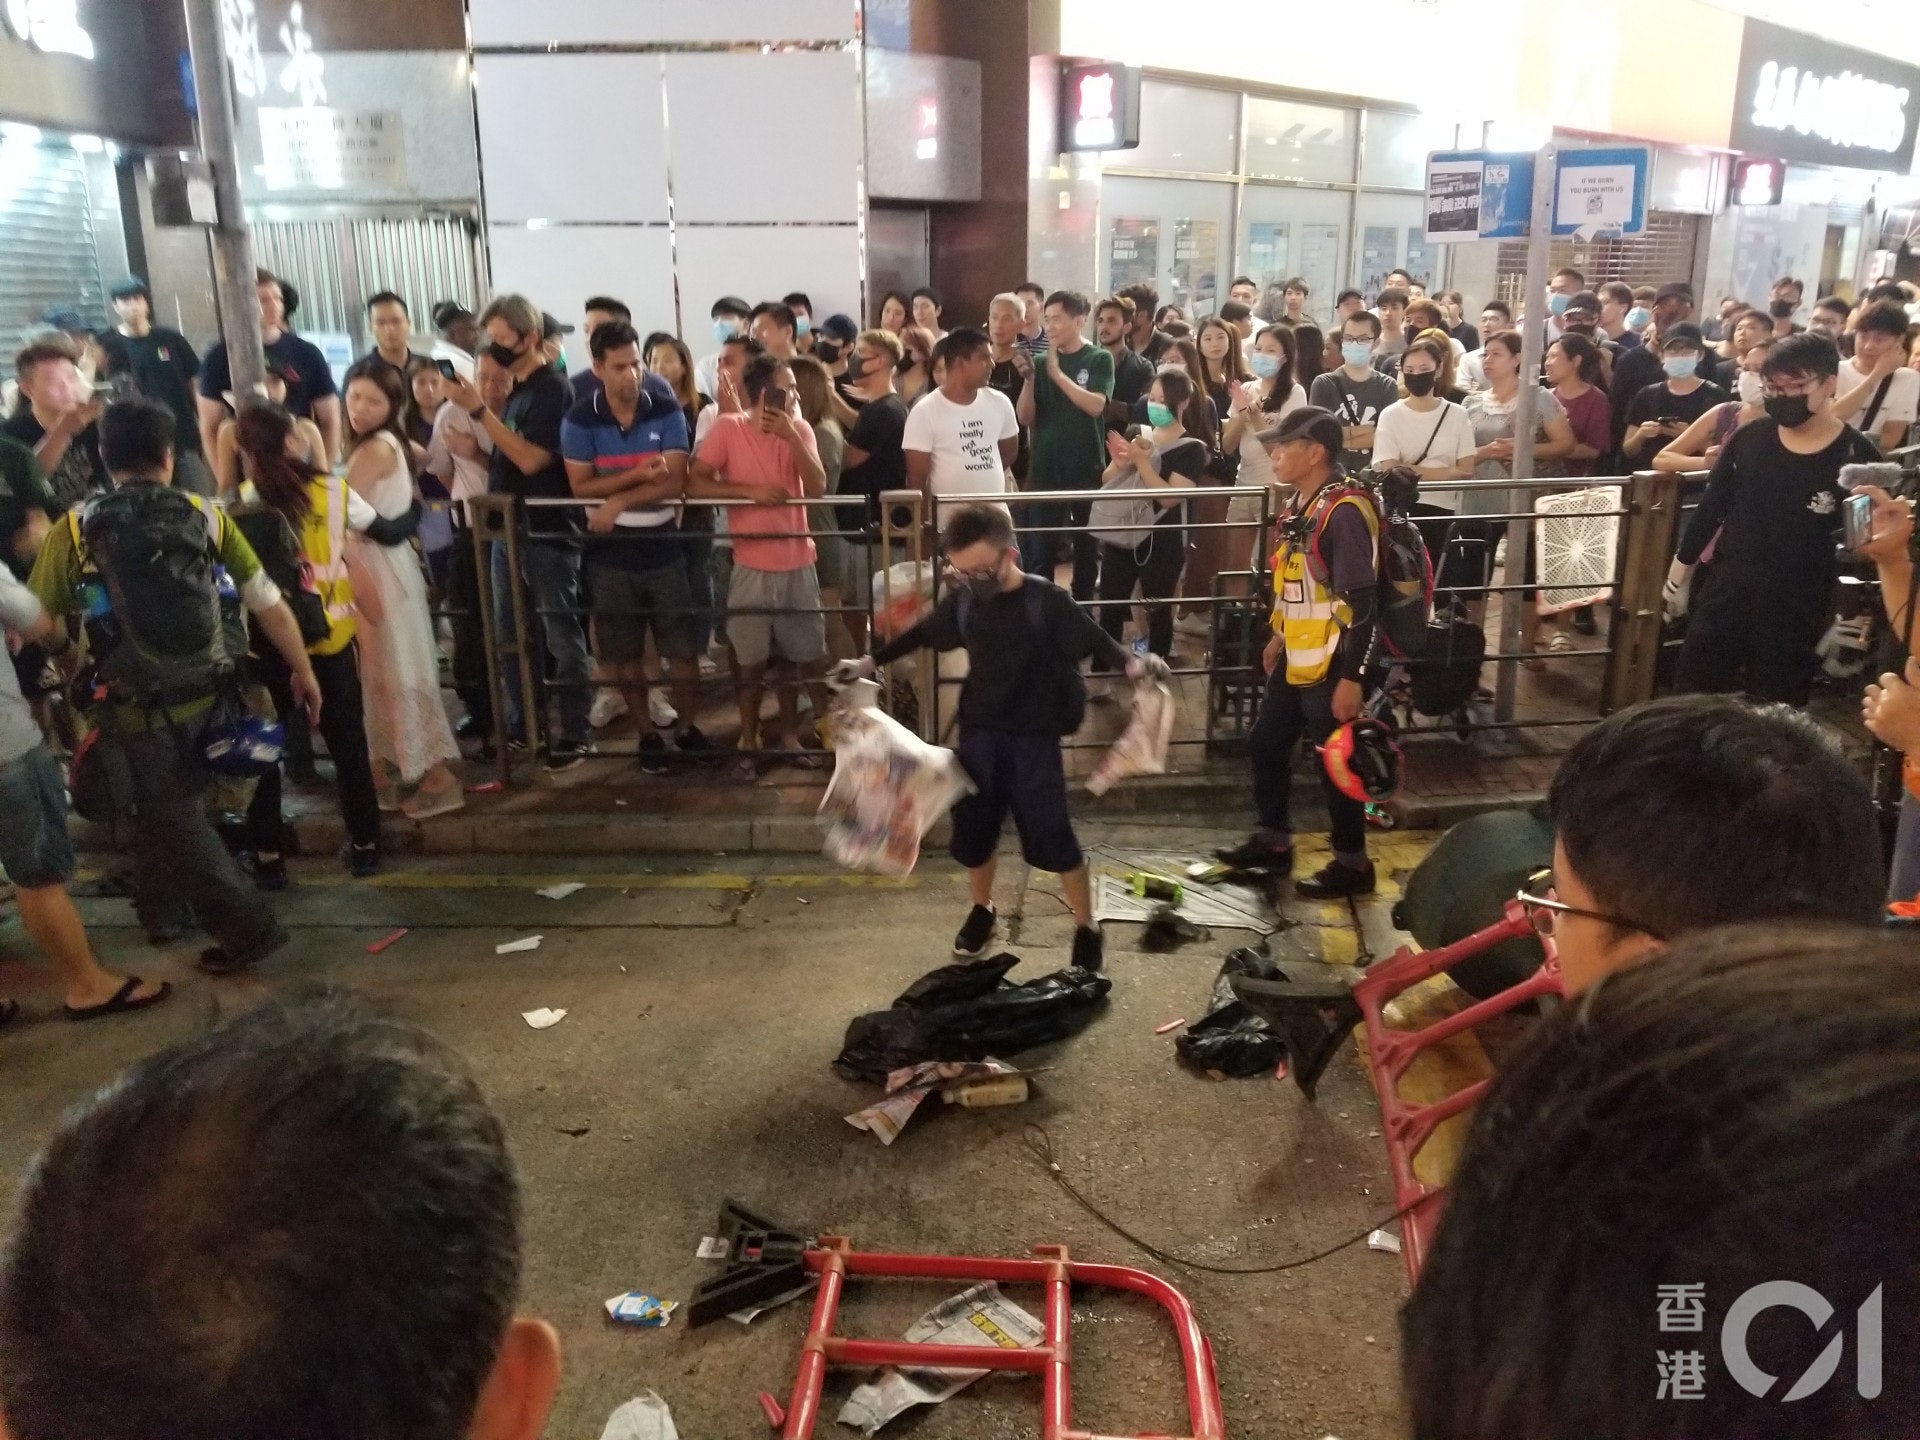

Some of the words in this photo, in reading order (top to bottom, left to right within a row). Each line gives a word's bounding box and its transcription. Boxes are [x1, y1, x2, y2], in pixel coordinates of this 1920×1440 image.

[959, 429, 984, 439] really
[962, 440, 976, 452] not
[970, 445, 993, 457] good
